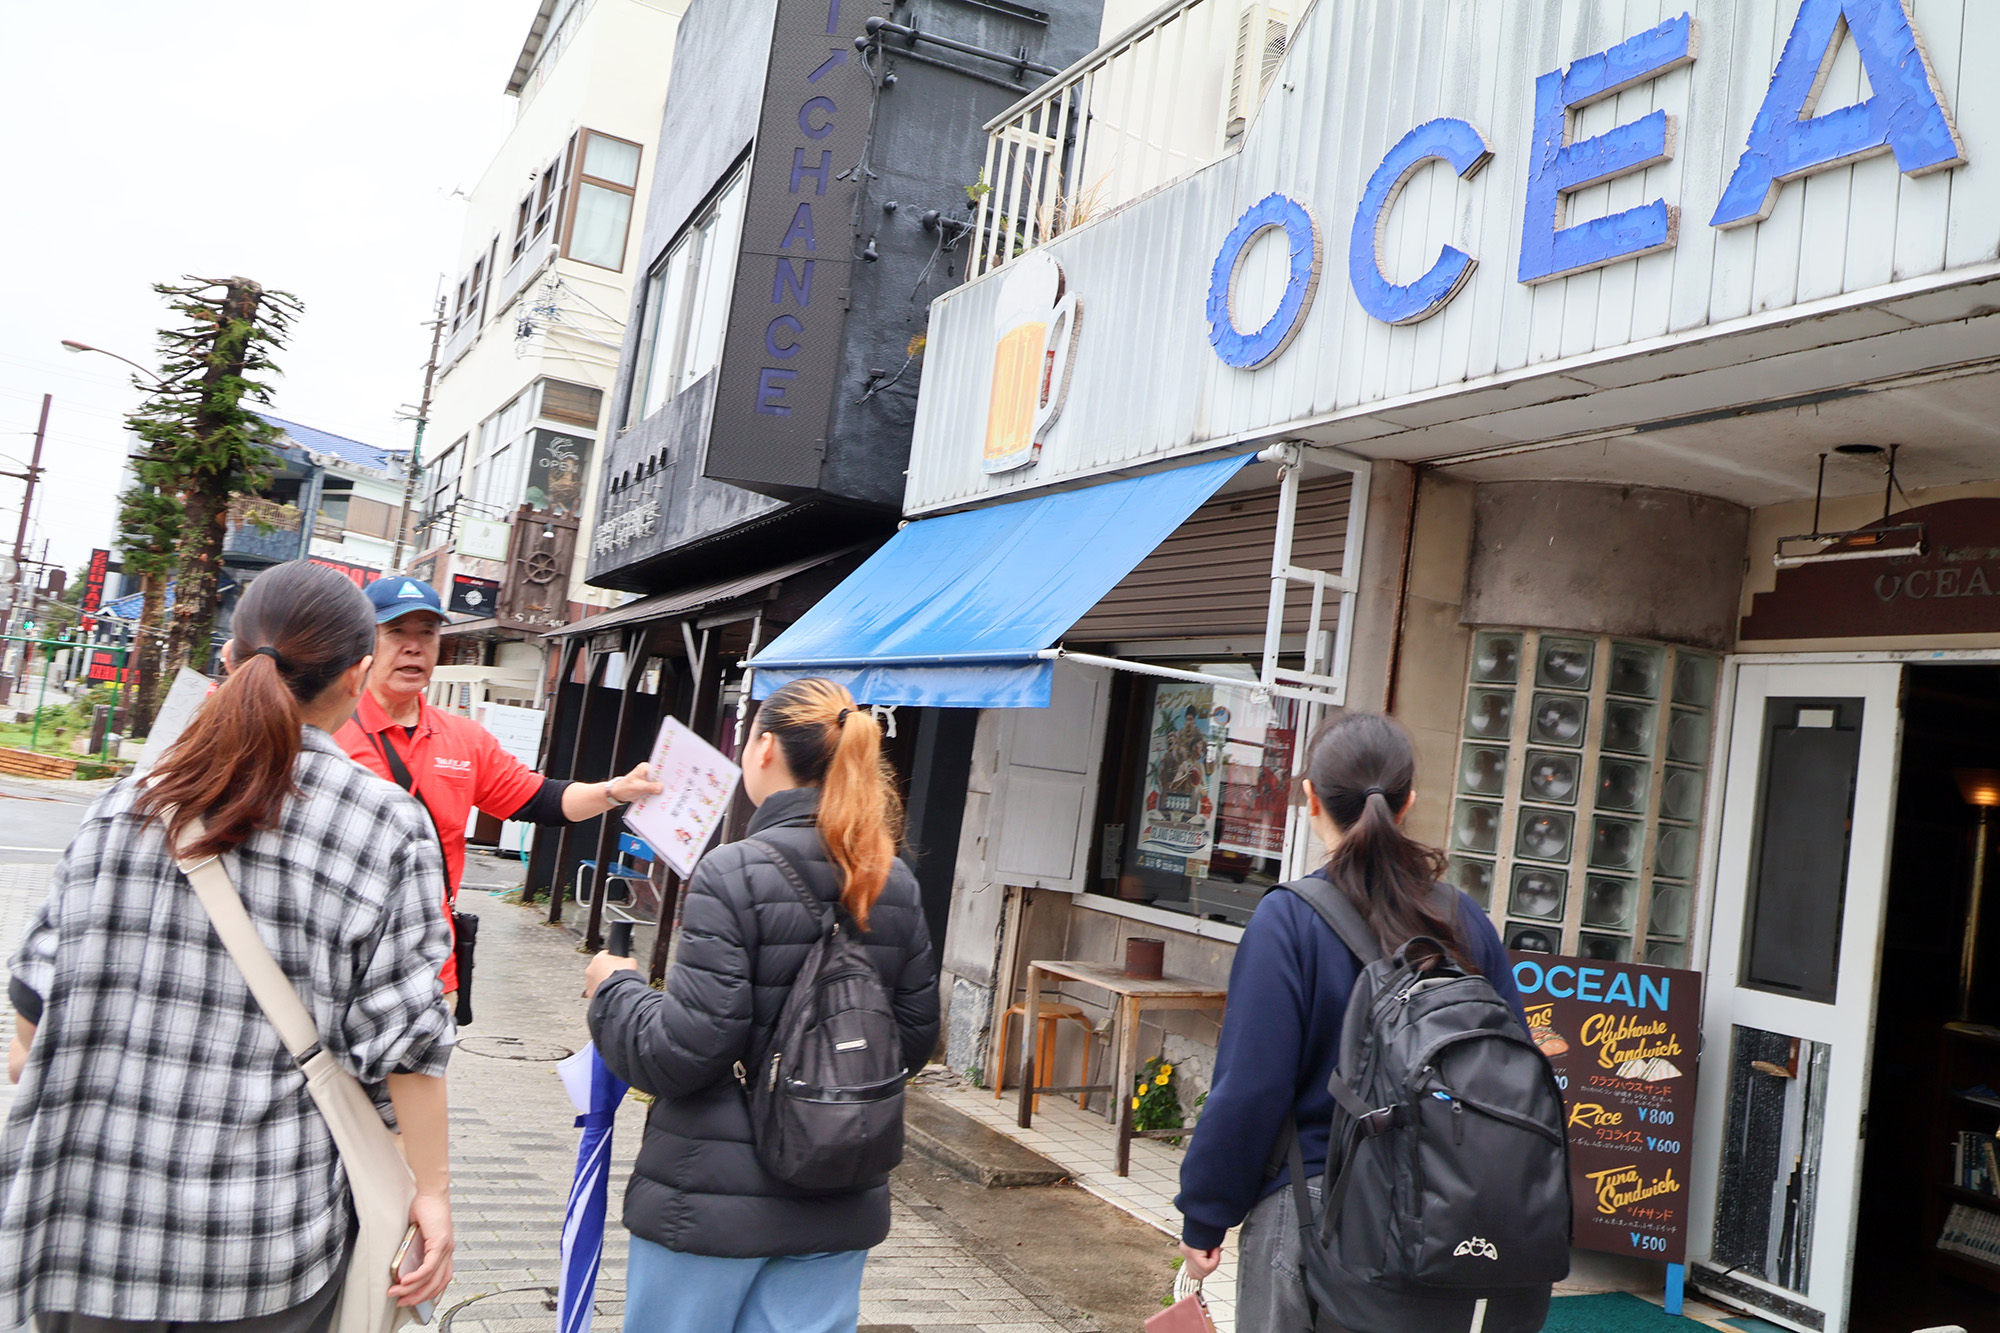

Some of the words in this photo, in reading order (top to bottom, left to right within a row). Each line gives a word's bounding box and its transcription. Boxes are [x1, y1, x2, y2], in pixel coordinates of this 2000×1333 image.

[755, 96, 838, 417] CHANCE
[1873, 566, 2000, 601] OCEA
[1512, 961, 1670, 1012] OCEAN
[1580, 1013, 1668, 1047] Clubhouse
[1597, 1034, 1683, 1069] Sandwich
[1589, 1075, 1673, 1096] クラブハウスサンド
[1568, 1102, 1623, 1129] Rice
[1638, 1107, 1674, 1126] ¥800
[1596, 1128, 1643, 1143] タコライス
[1646, 1136, 1681, 1154] ¥600
[1585, 1165, 1639, 1194] Tuna
[1597, 1168, 1680, 1214] Sandwich
[1627, 1206, 1673, 1221] ツナサンド
[1630, 1232, 1667, 1252] ¥500
